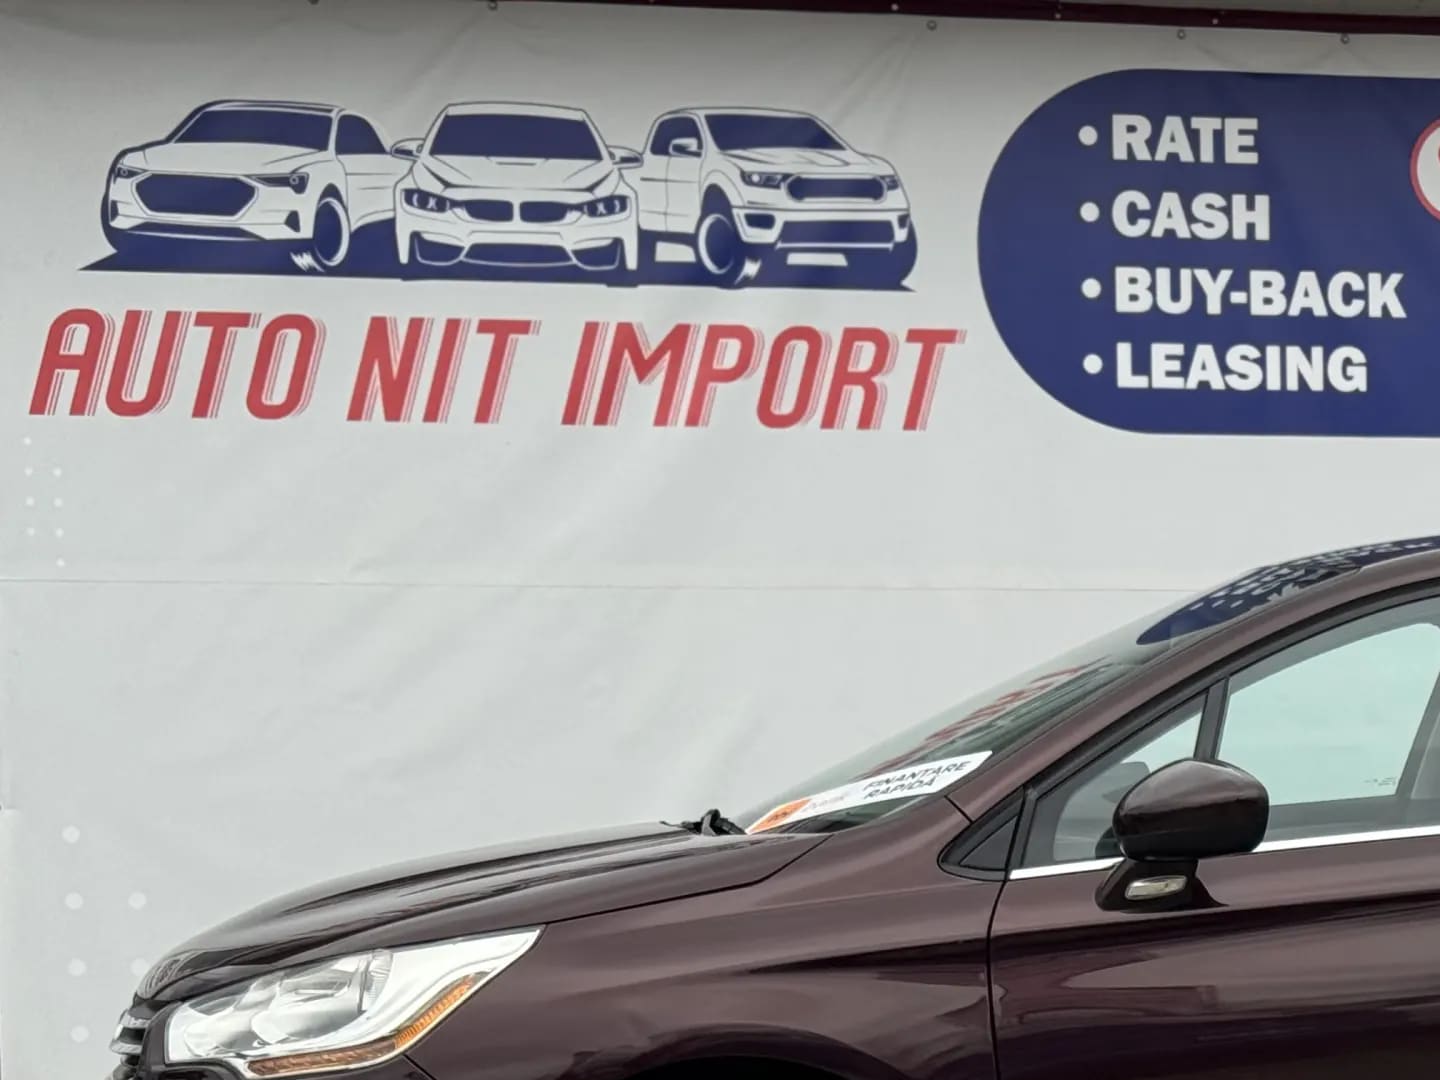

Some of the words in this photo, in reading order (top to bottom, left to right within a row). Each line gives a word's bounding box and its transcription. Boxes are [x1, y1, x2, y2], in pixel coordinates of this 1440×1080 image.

[1111, 113, 1259, 165] RATE
[1111, 189, 1271, 241] CASH
[1114, 265, 1408, 319] BUY-BACK
[28, 307, 328, 420] AUTO
[346, 315, 542, 424] NIT
[560, 320, 967, 431] IMPORT
[1115, 341, 1369, 393] LEASING
